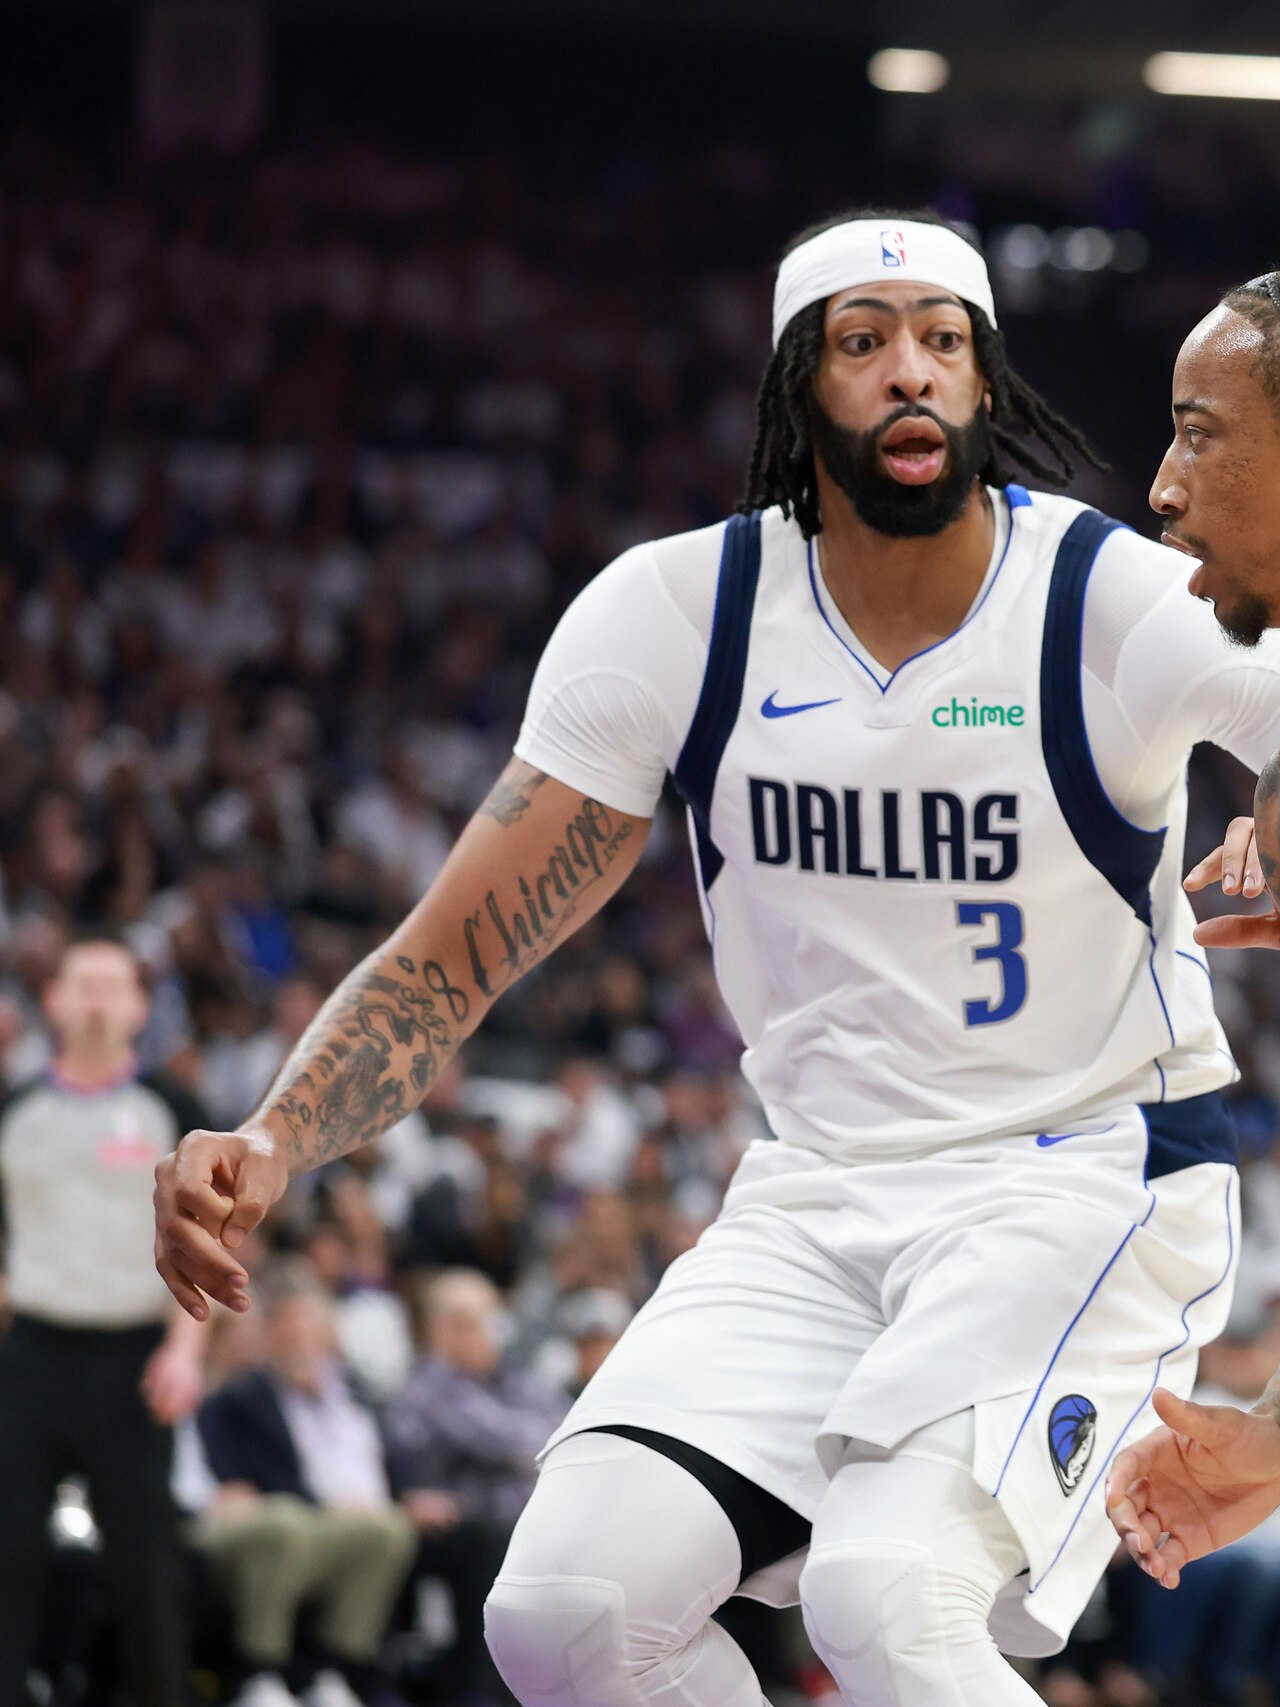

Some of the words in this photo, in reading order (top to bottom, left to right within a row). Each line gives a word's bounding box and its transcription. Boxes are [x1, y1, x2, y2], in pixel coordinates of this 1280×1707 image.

[932, 697, 1025, 727] chime
[747, 774, 1021, 884] DALLAS
[953, 899, 1030, 1032] 3
